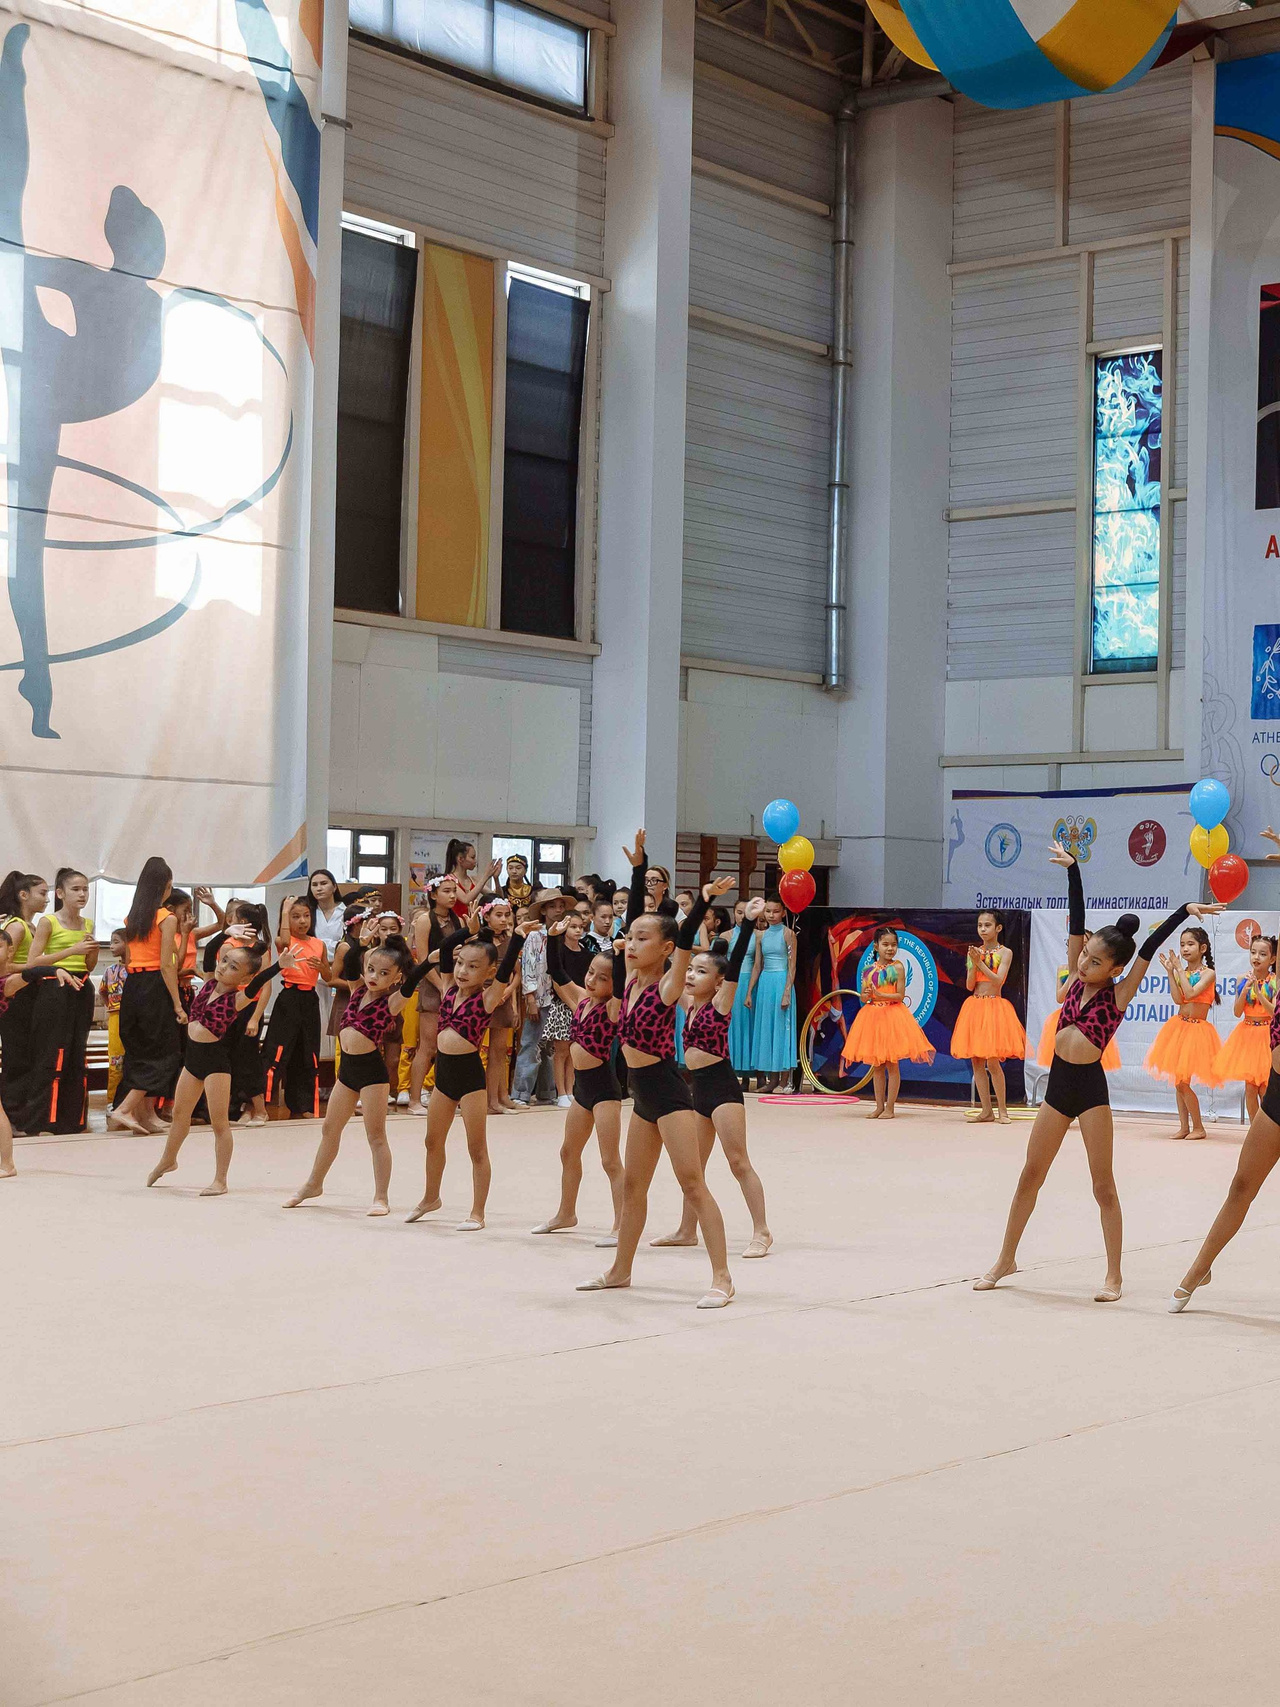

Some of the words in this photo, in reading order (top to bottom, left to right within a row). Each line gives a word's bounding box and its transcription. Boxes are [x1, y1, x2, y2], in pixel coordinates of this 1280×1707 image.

[1046, 897, 1068, 909] топт
[1086, 896, 1169, 909] гимнастикадан
[903, 937, 916, 949] THE
[915, 946, 934, 979] REPUBLIC
[928, 980, 934, 991] OF
